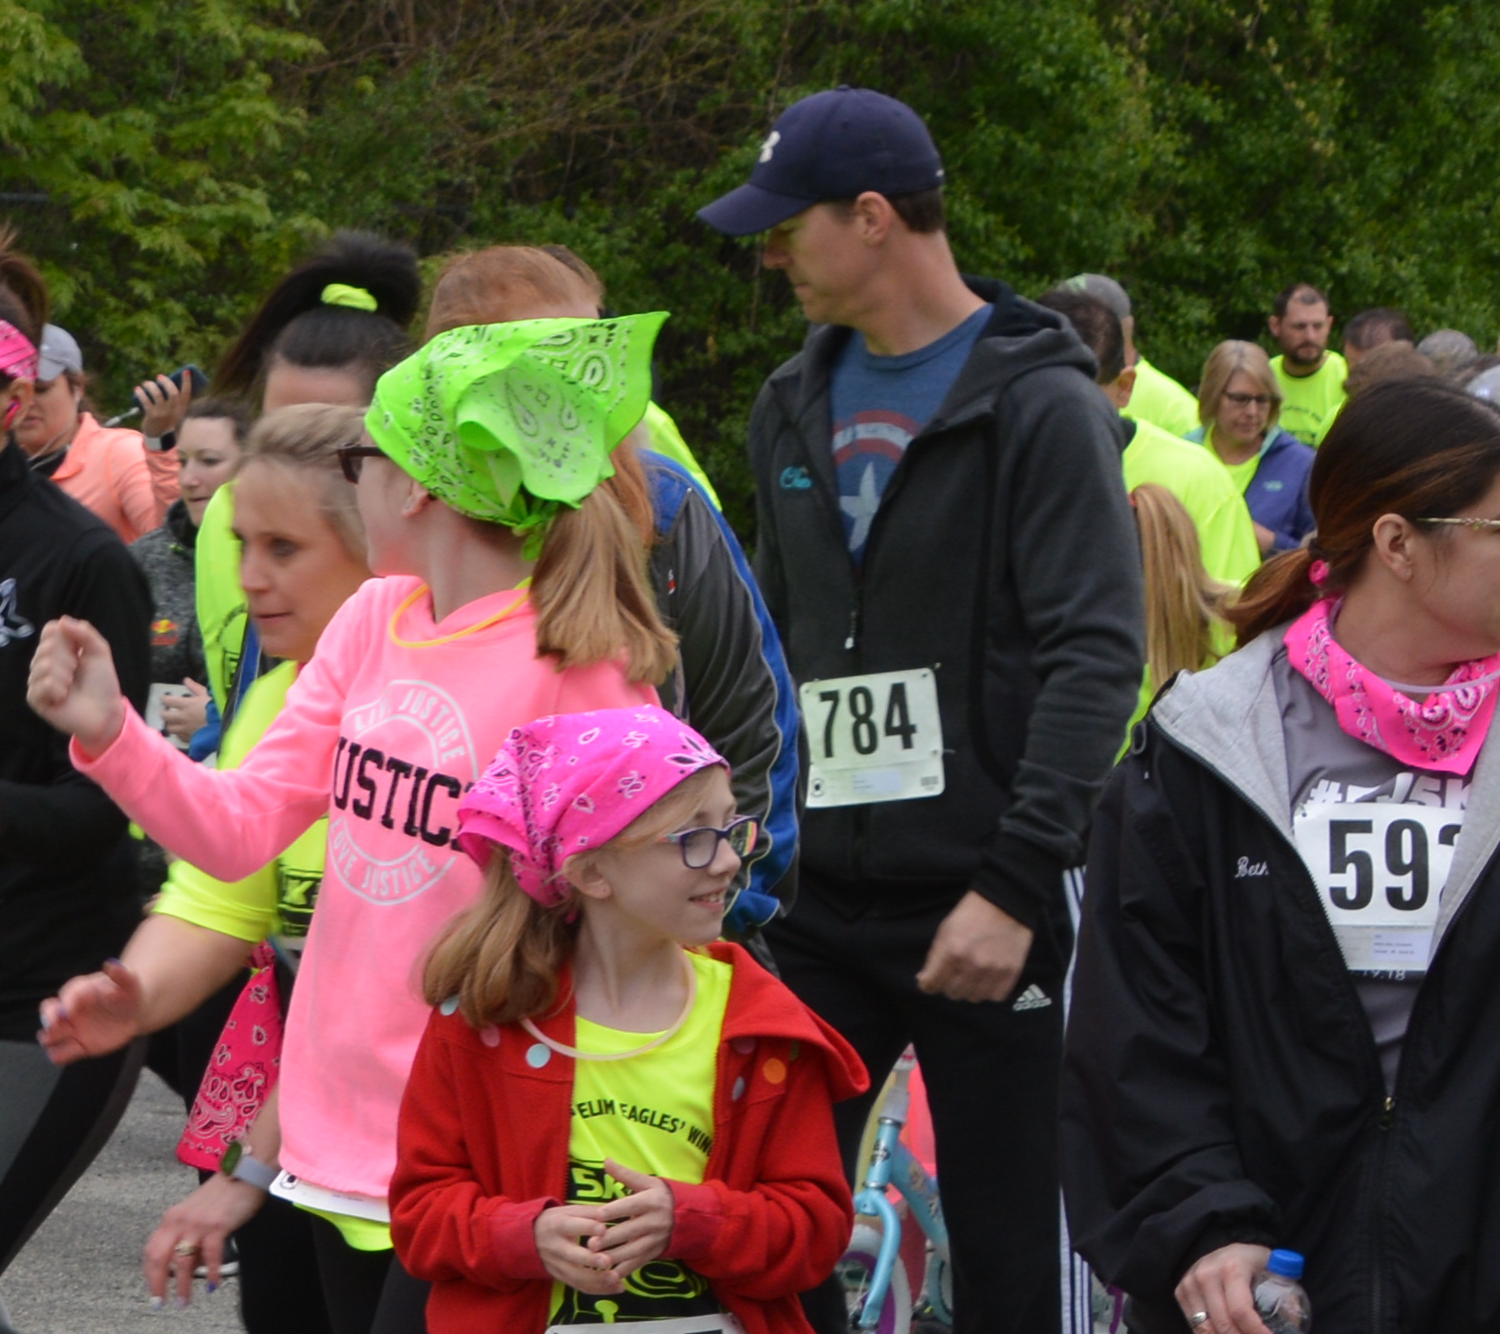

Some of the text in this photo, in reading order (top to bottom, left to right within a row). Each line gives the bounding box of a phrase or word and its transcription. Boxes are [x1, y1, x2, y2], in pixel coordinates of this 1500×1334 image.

[398, 688, 467, 764] JUSTICE
[819, 682, 918, 759] 784
[576, 1099, 616, 1120] ELIM
[617, 1102, 687, 1134] EAGLES'
[571, 1167, 625, 1199] 5K
